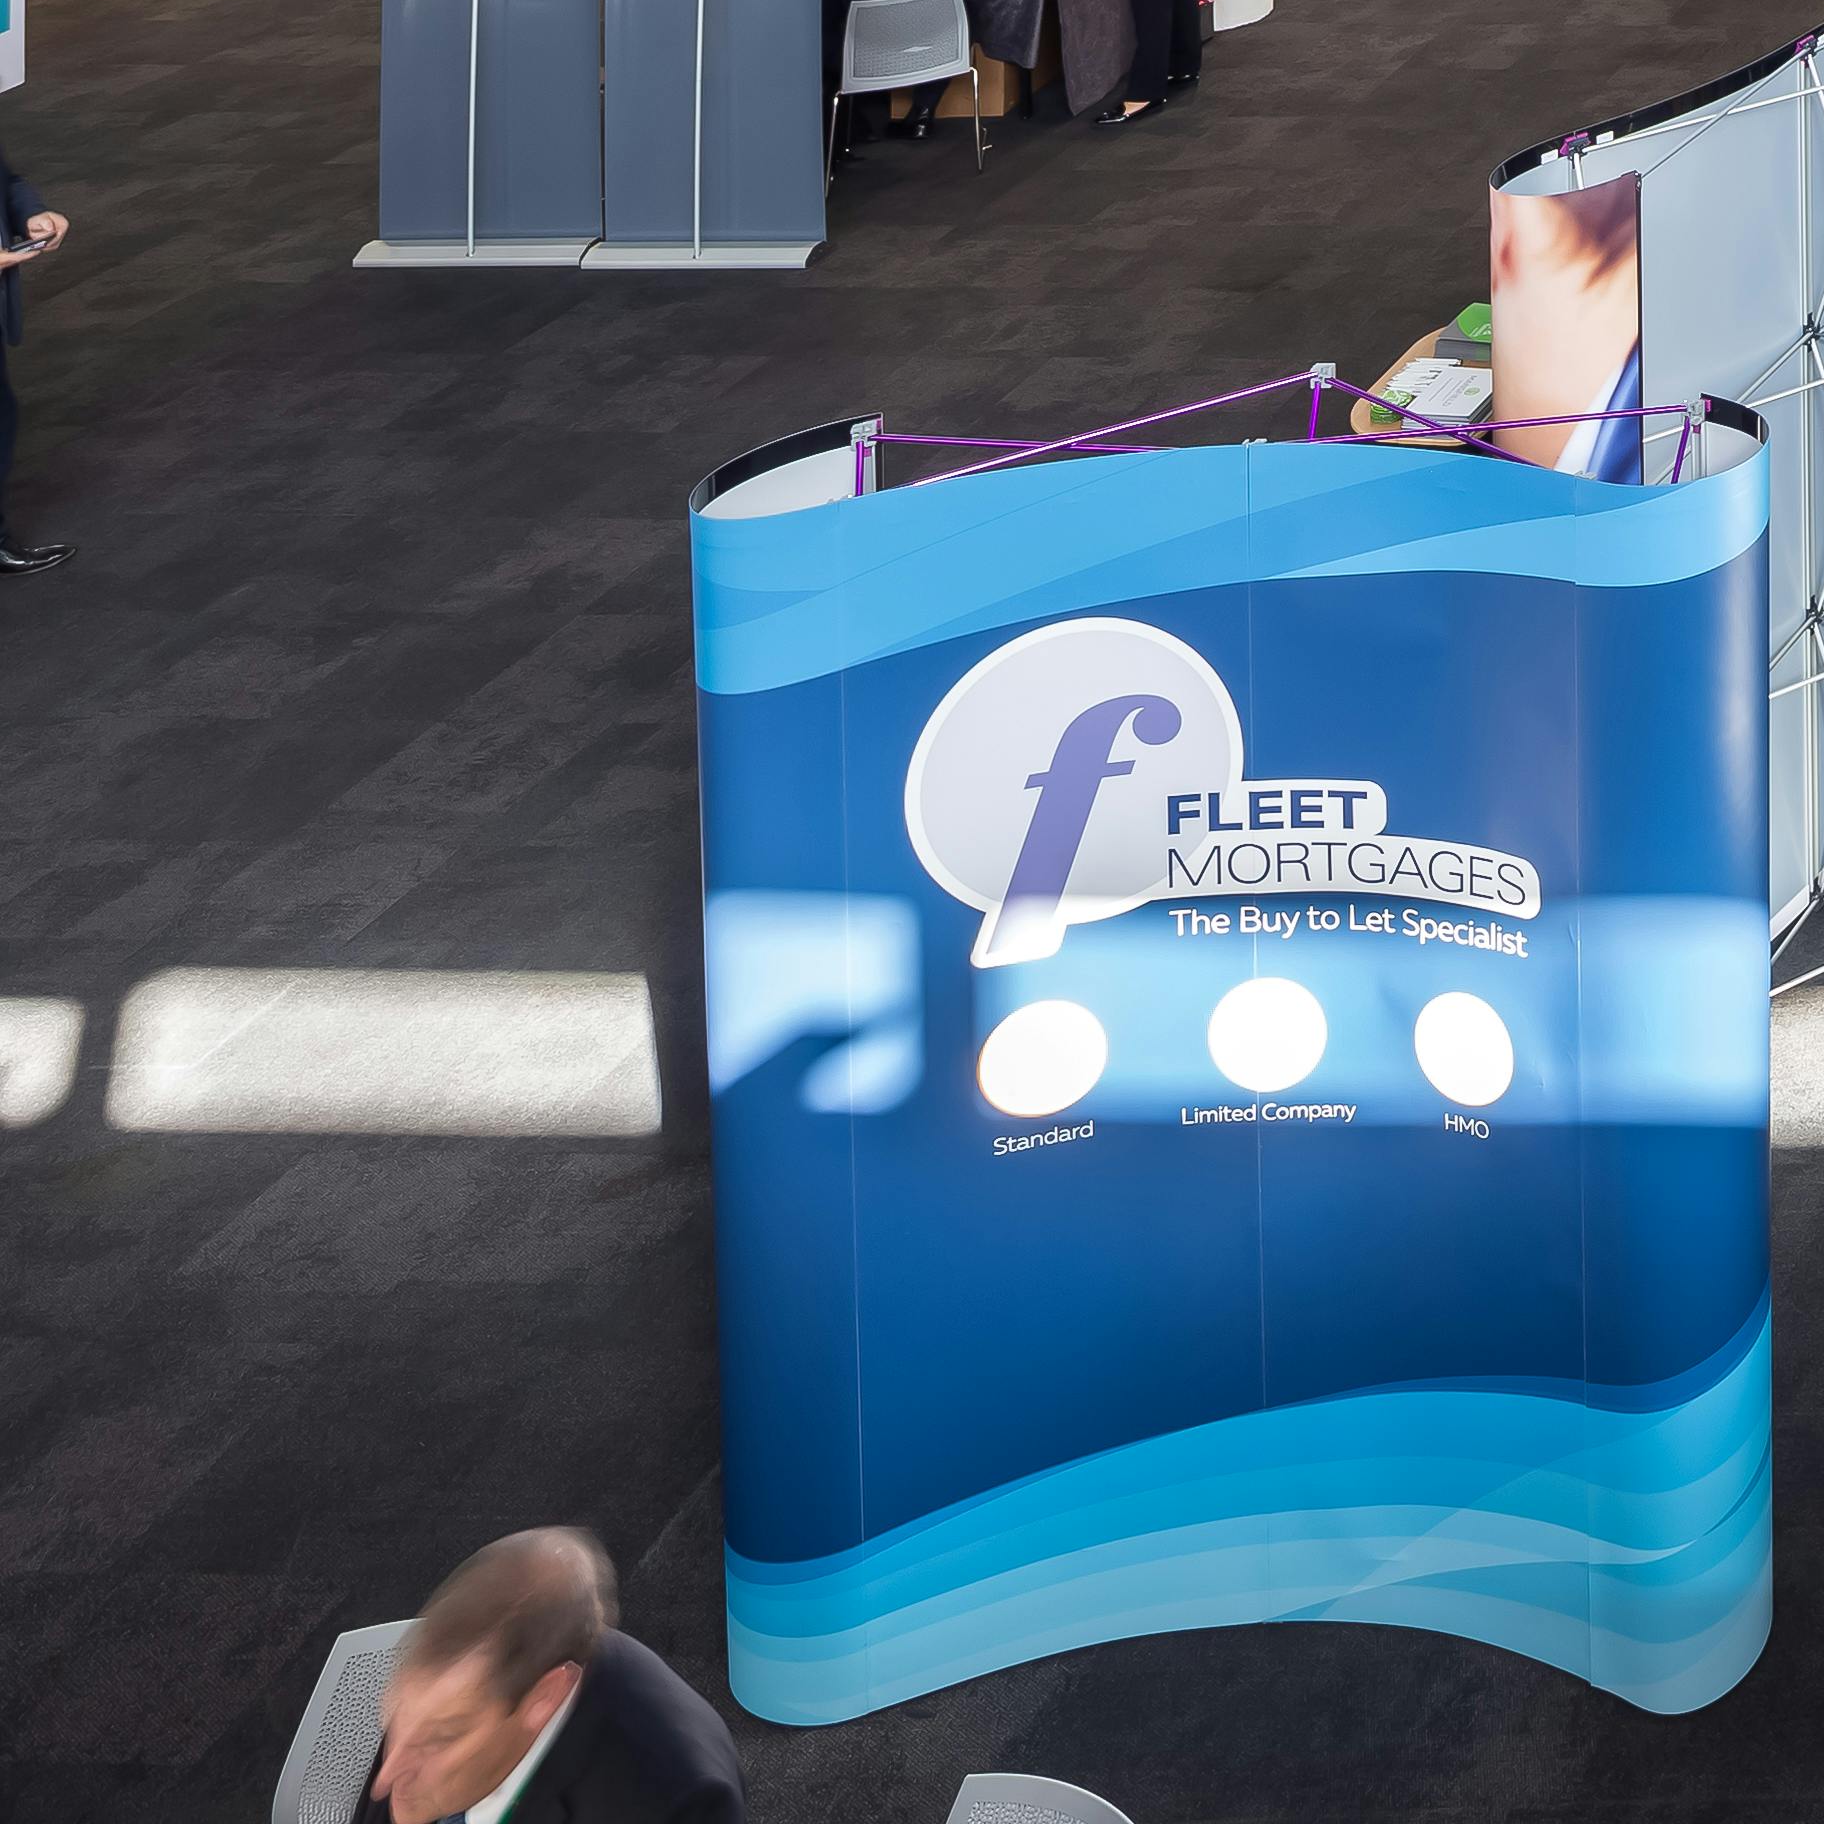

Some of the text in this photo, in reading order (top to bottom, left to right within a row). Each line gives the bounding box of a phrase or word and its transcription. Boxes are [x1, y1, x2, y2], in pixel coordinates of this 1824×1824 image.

[1166, 789, 1367, 835] FLEET
[1167, 841, 1527, 908] MORTGAGES
[1168, 904, 1529, 958] The Buy to Let Specialist
[1181, 1101, 1356, 1126] Limited Company
[1444, 1113, 1490, 1139] HMO
[993, 1120, 1094, 1157] Standard
